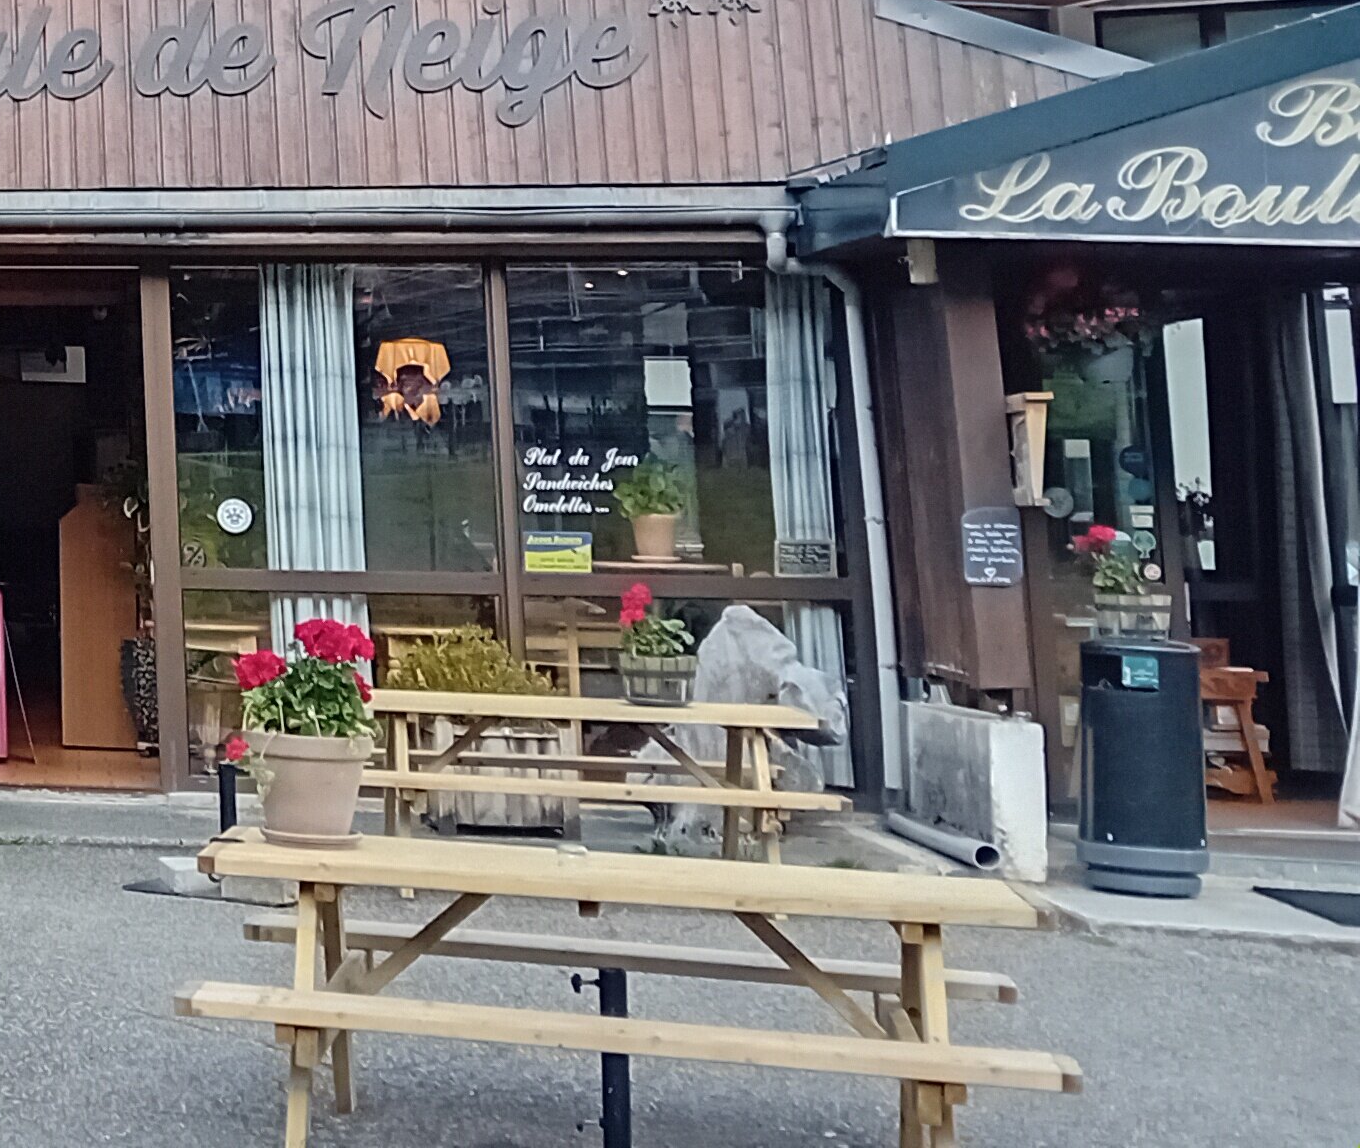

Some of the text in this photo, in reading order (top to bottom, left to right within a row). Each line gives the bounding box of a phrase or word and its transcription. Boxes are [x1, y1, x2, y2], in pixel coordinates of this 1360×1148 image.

[134, 1, 277, 96] de
[1256, 77, 1360, 146] B
[959, 152, 1102, 222] La
[523, 472, 613, 491] Sandwiches
[524, 447, 638, 472] Plat du Jour
